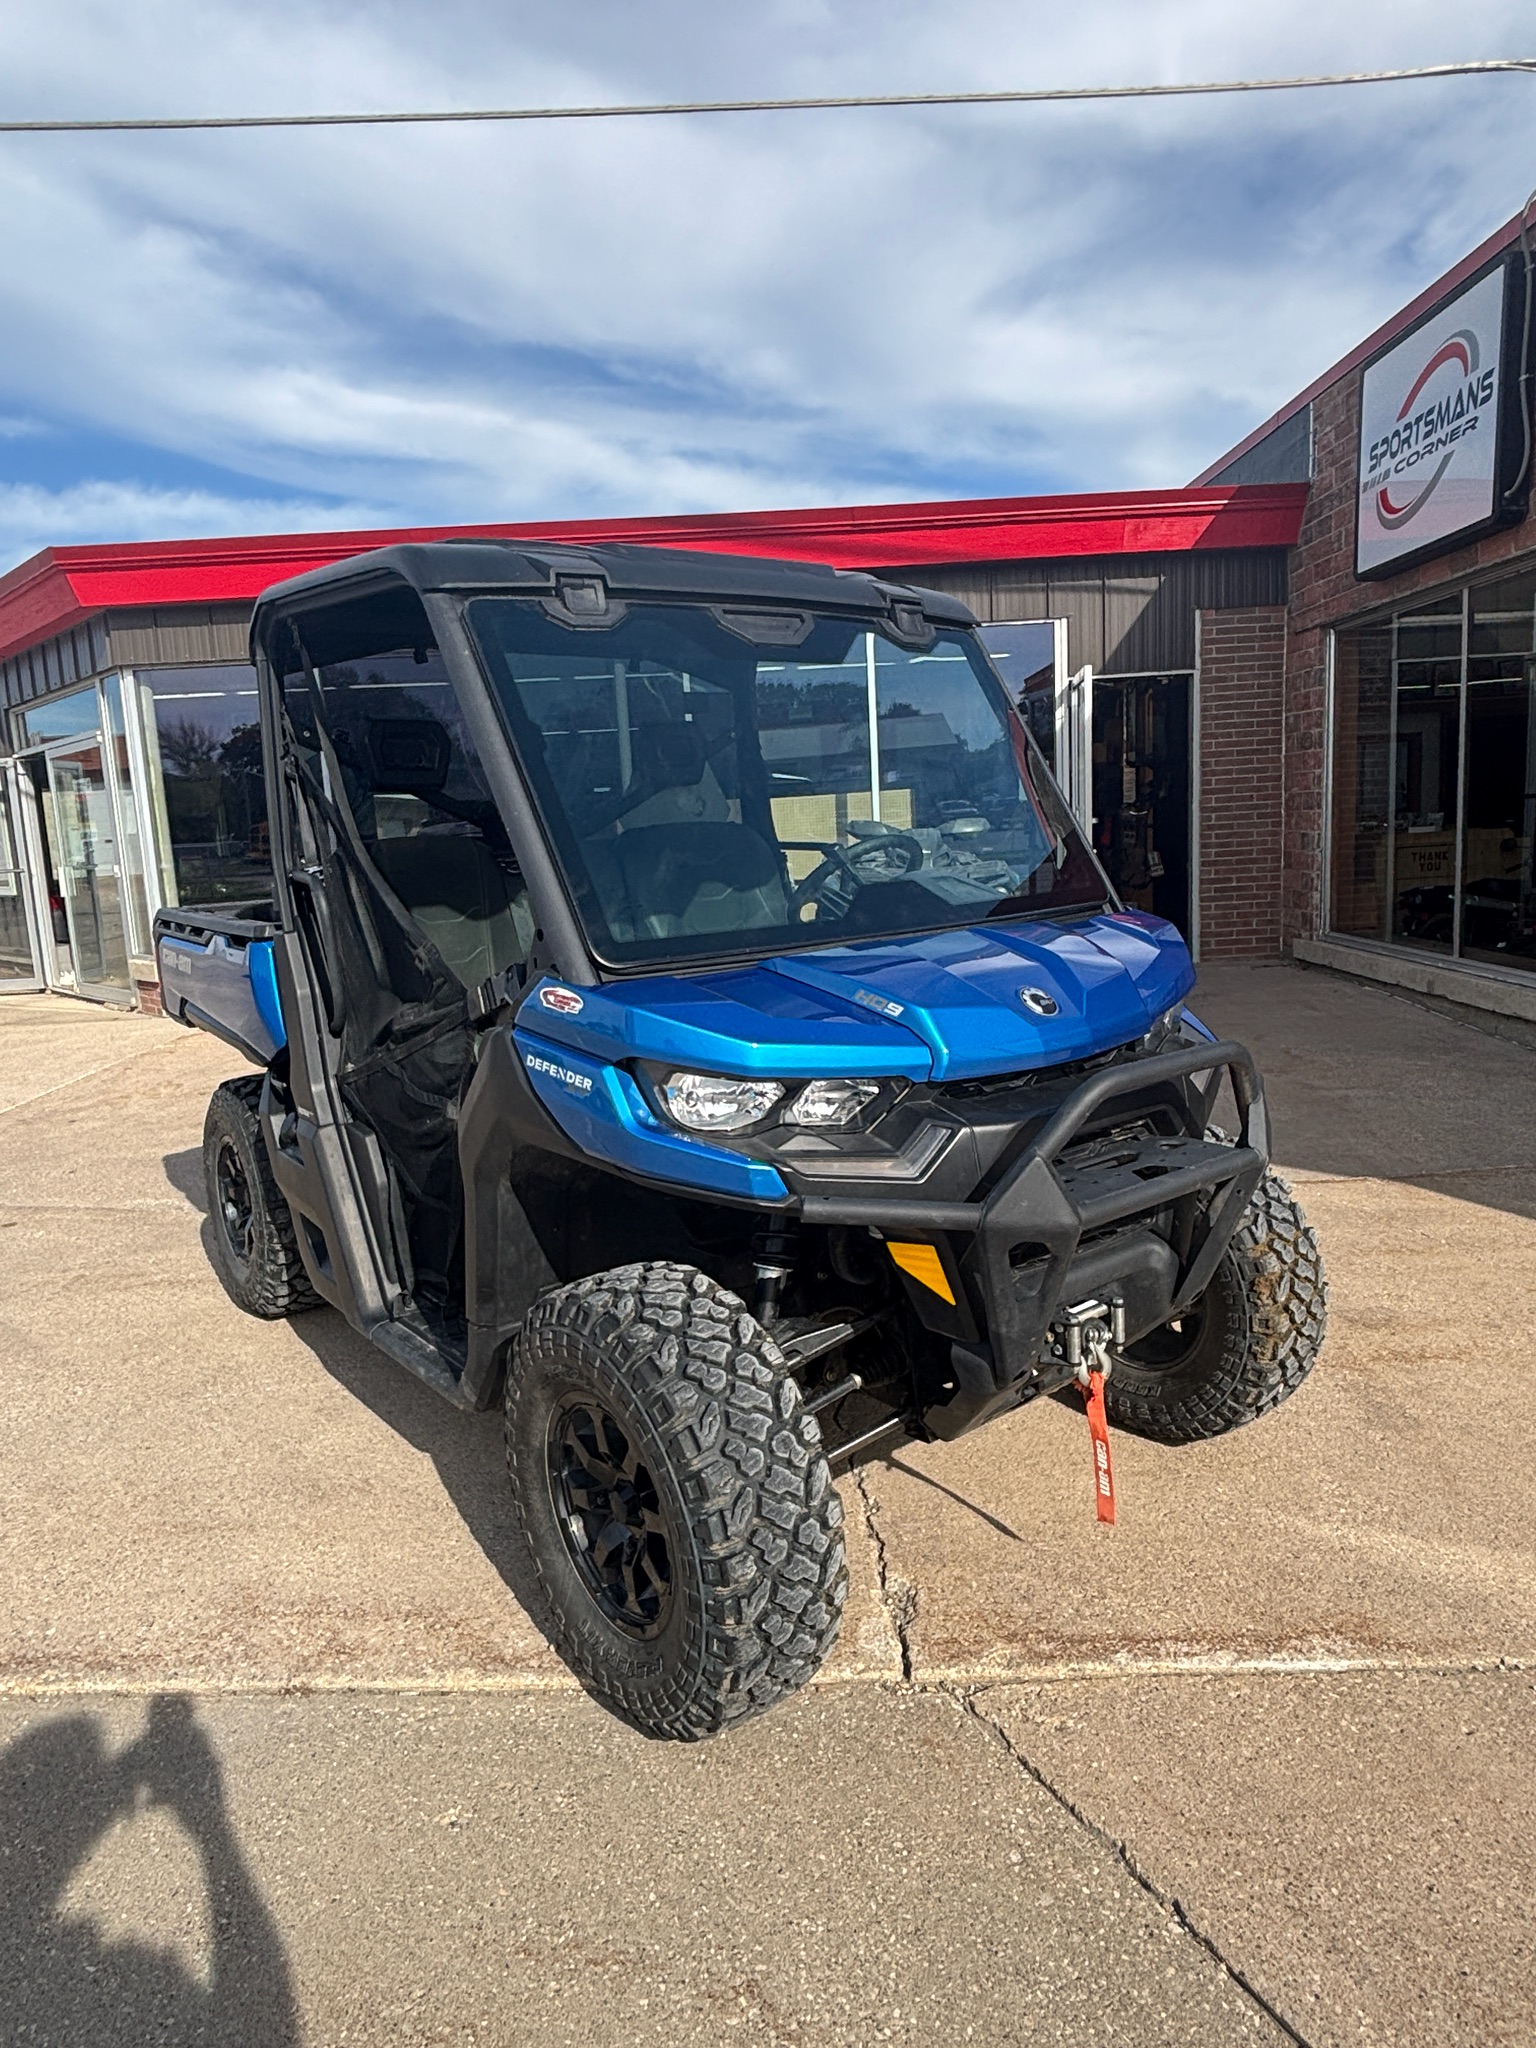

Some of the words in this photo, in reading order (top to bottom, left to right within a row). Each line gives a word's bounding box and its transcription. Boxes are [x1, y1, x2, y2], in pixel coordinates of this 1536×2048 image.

[1368, 367, 1495, 474] SPORTSMANS
[1394, 415, 1479, 474] CORNER
[1411, 851, 1449, 862] THANK
[1419, 861, 1441, 872] YOU
[526, 1053, 592, 1091] DEFENDER
